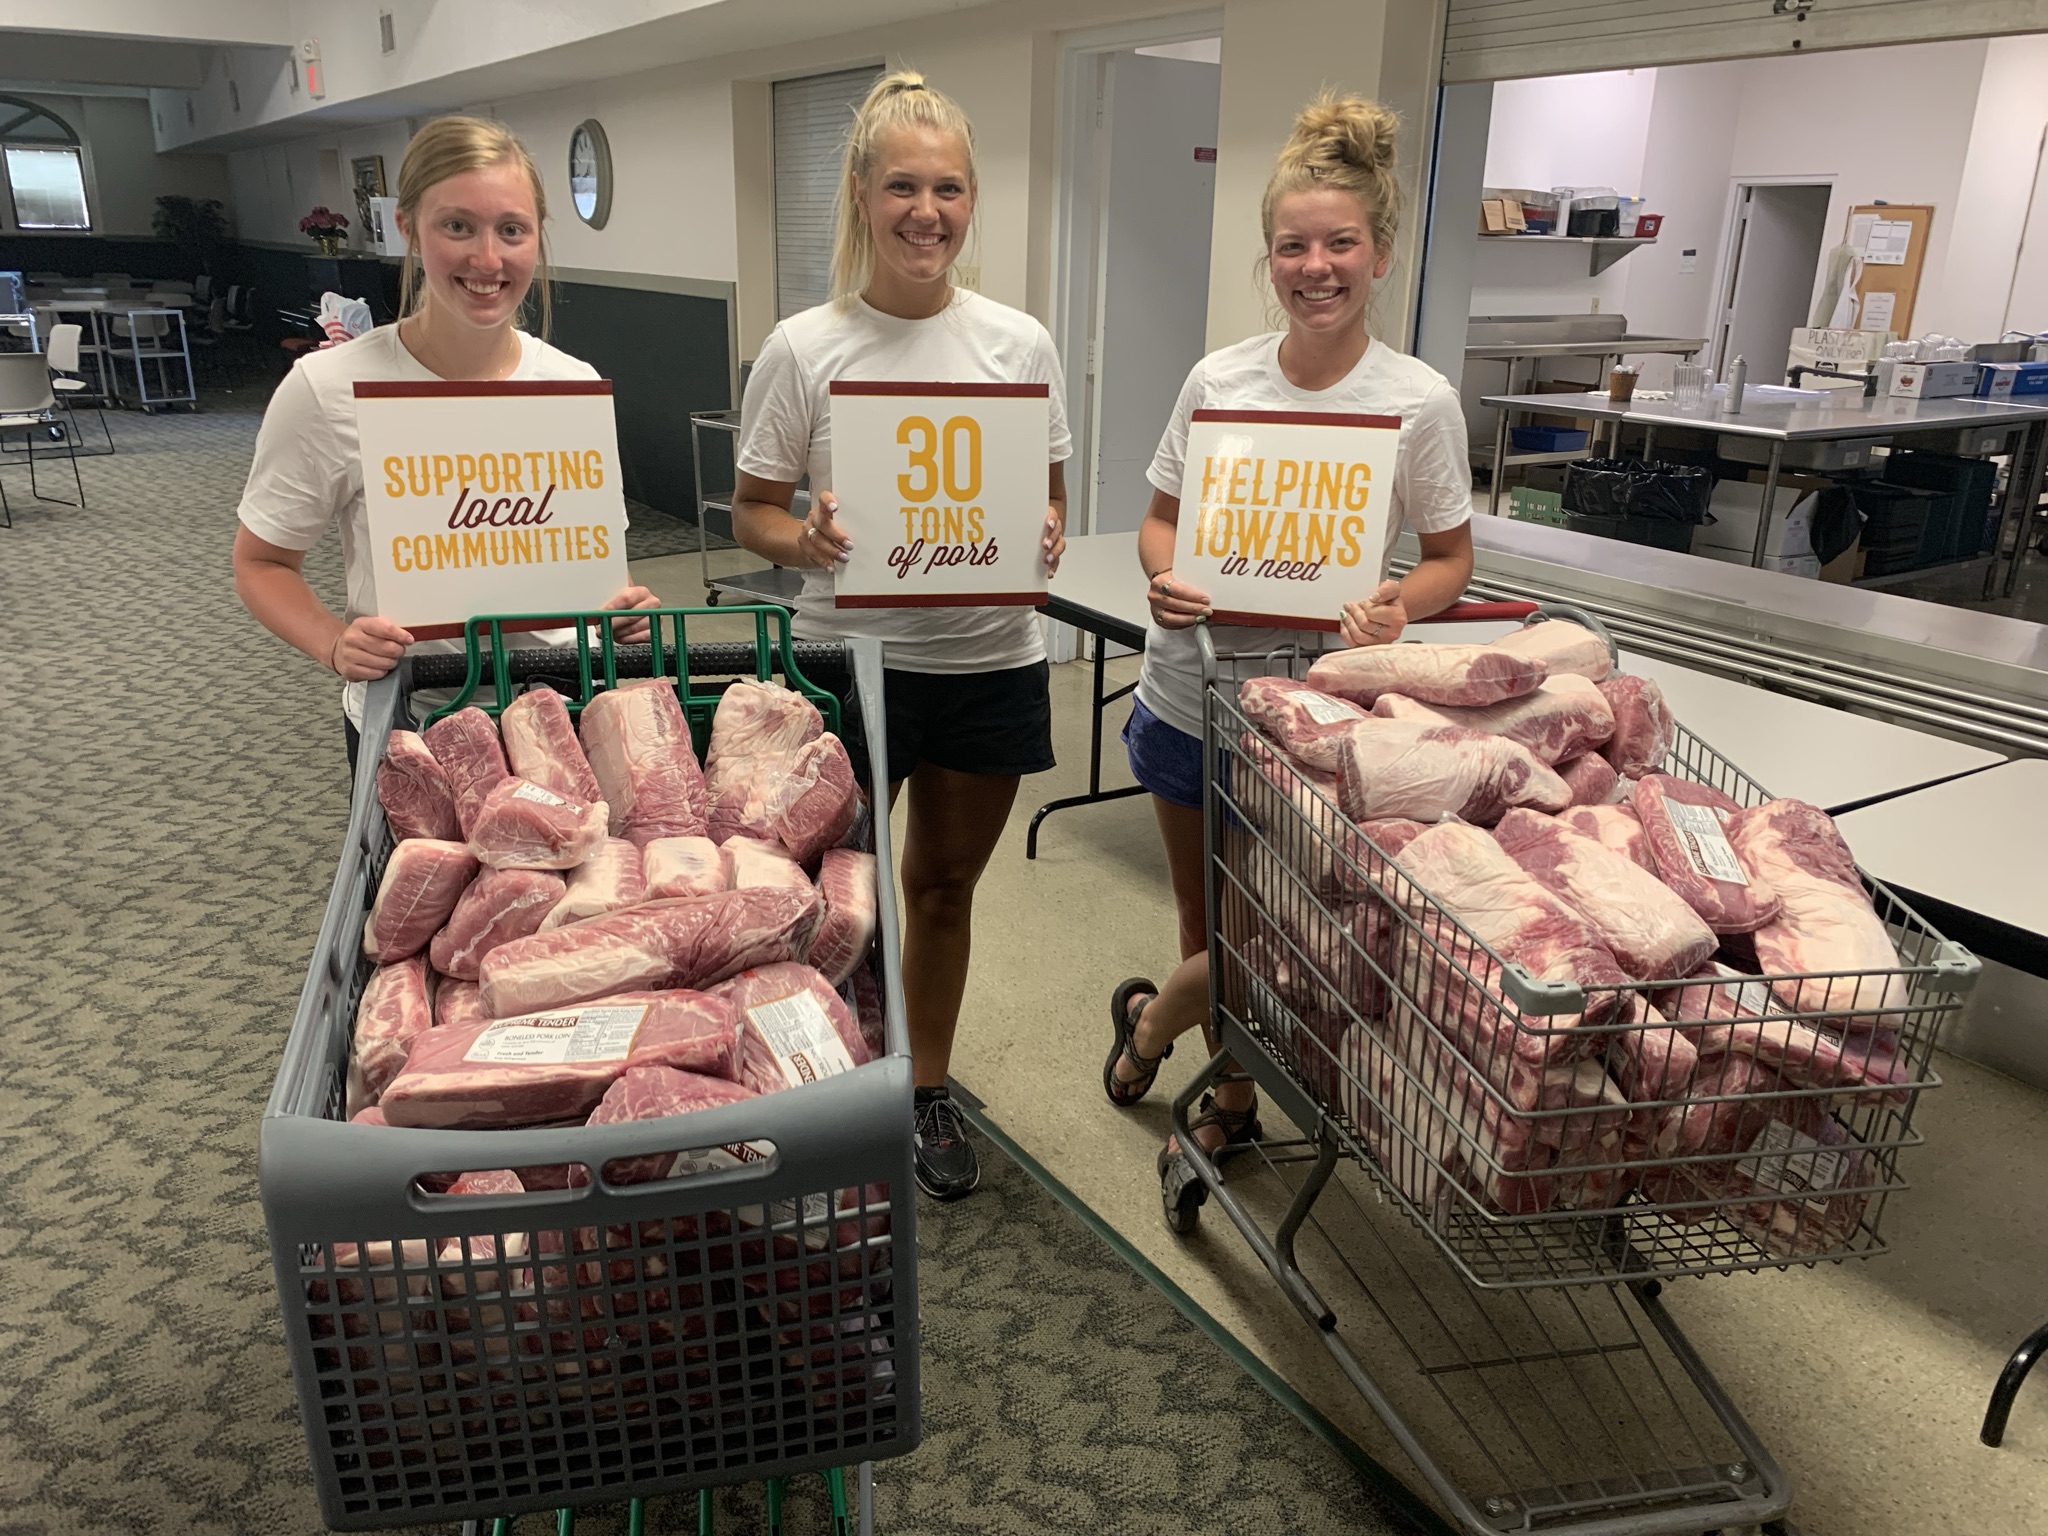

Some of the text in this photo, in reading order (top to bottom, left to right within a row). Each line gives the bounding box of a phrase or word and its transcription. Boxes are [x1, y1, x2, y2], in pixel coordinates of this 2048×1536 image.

[1808, 330, 1857, 347] PLASTIC
[1815, 345, 1842, 358] ONLY
[383, 449, 604, 498] SUPPORTING
[896, 415, 982, 503] 30
[1200, 456, 1372, 512] HELPING
[448, 484, 556, 530] local
[899, 506, 985, 544] TONS
[392, 524, 610, 572] COMMUNITIES
[1193, 506, 1366, 568] IOWANS
[887, 537, 999, 580] of pork
[1220, 550, 1328, 582] in need
[504, 1032, 571, 1041] BONELESS PORK LOIN
[537, 1016, 576, 1027] TENDER
[793, 1054, 815, 1084] ENDER
